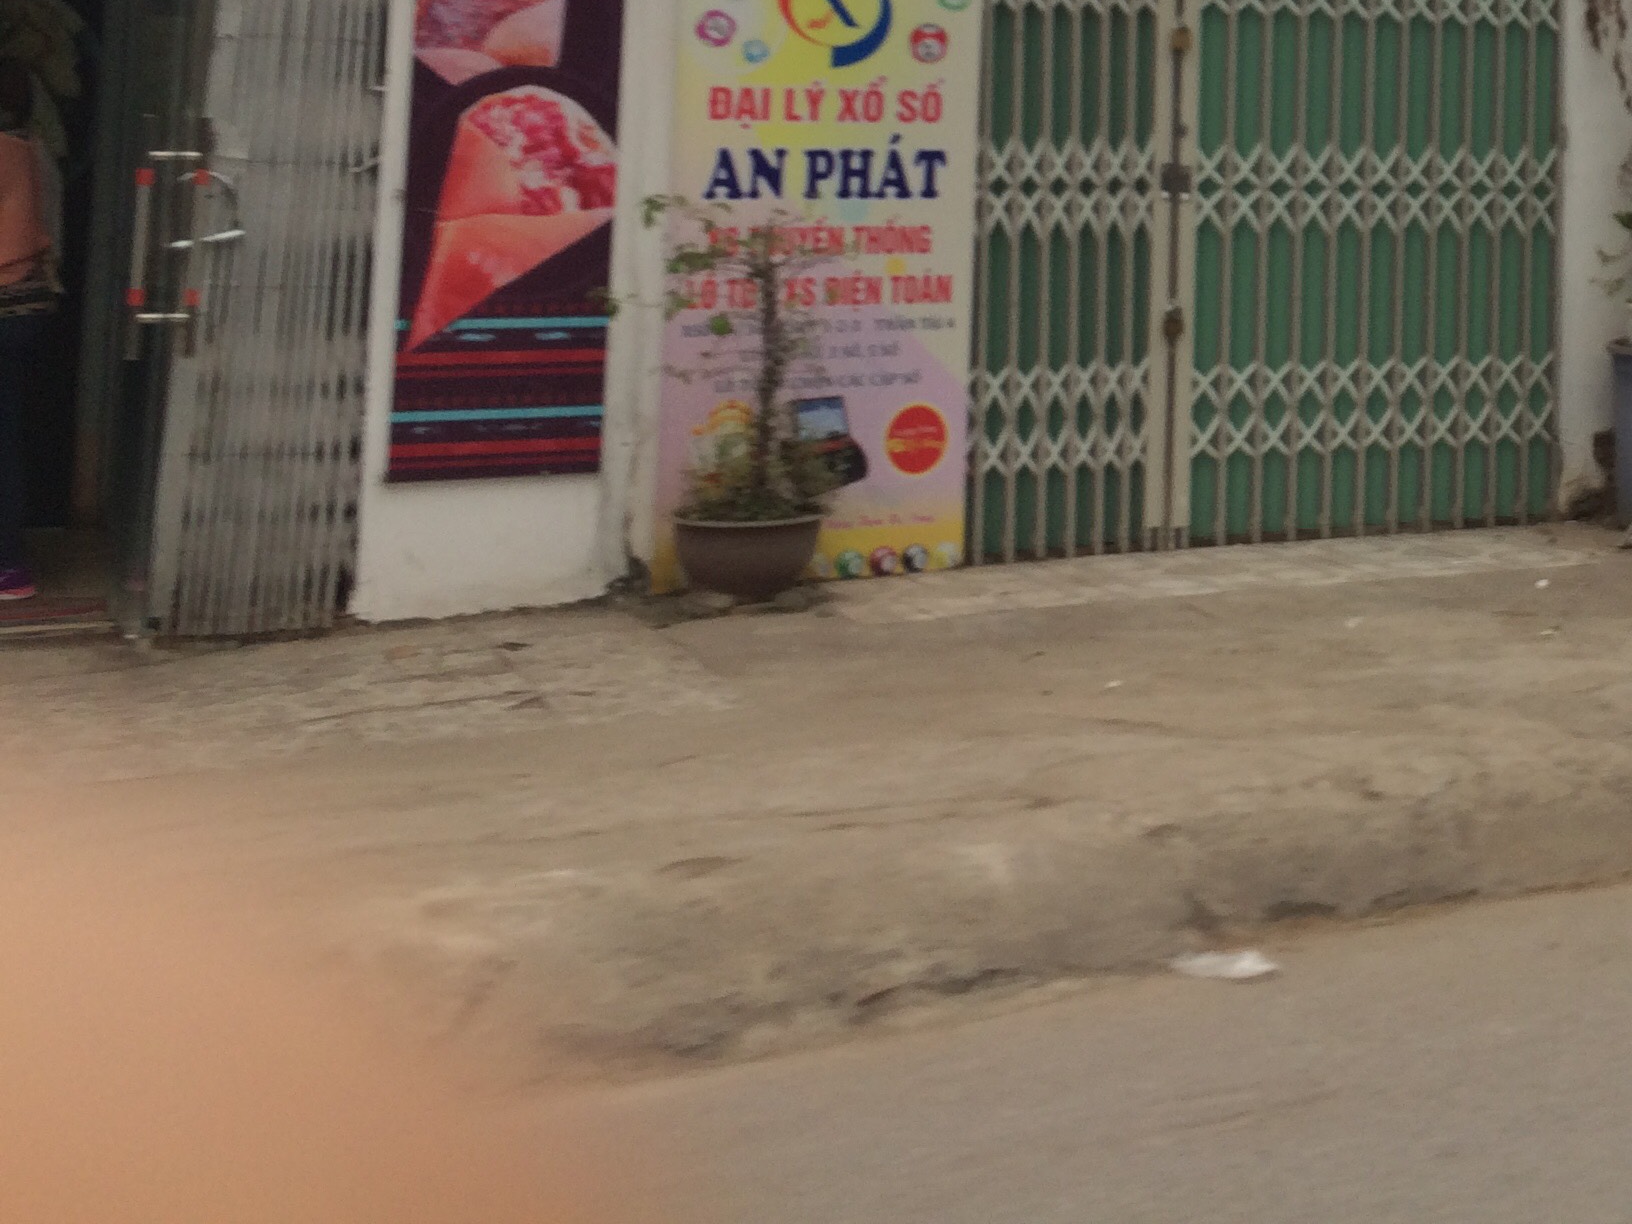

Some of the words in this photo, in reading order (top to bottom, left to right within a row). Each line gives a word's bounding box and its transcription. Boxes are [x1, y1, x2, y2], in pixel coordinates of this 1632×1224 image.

[707, 85, 771, 130] ĐẠI
[784, 79, 825, 123] LÝ
[836, 74, 888, 124] XỔ
[896, 77, 945, 124] SỐ
[703, 146, 790, 200] AN
[803, 131, 948, 200] PHÁT
